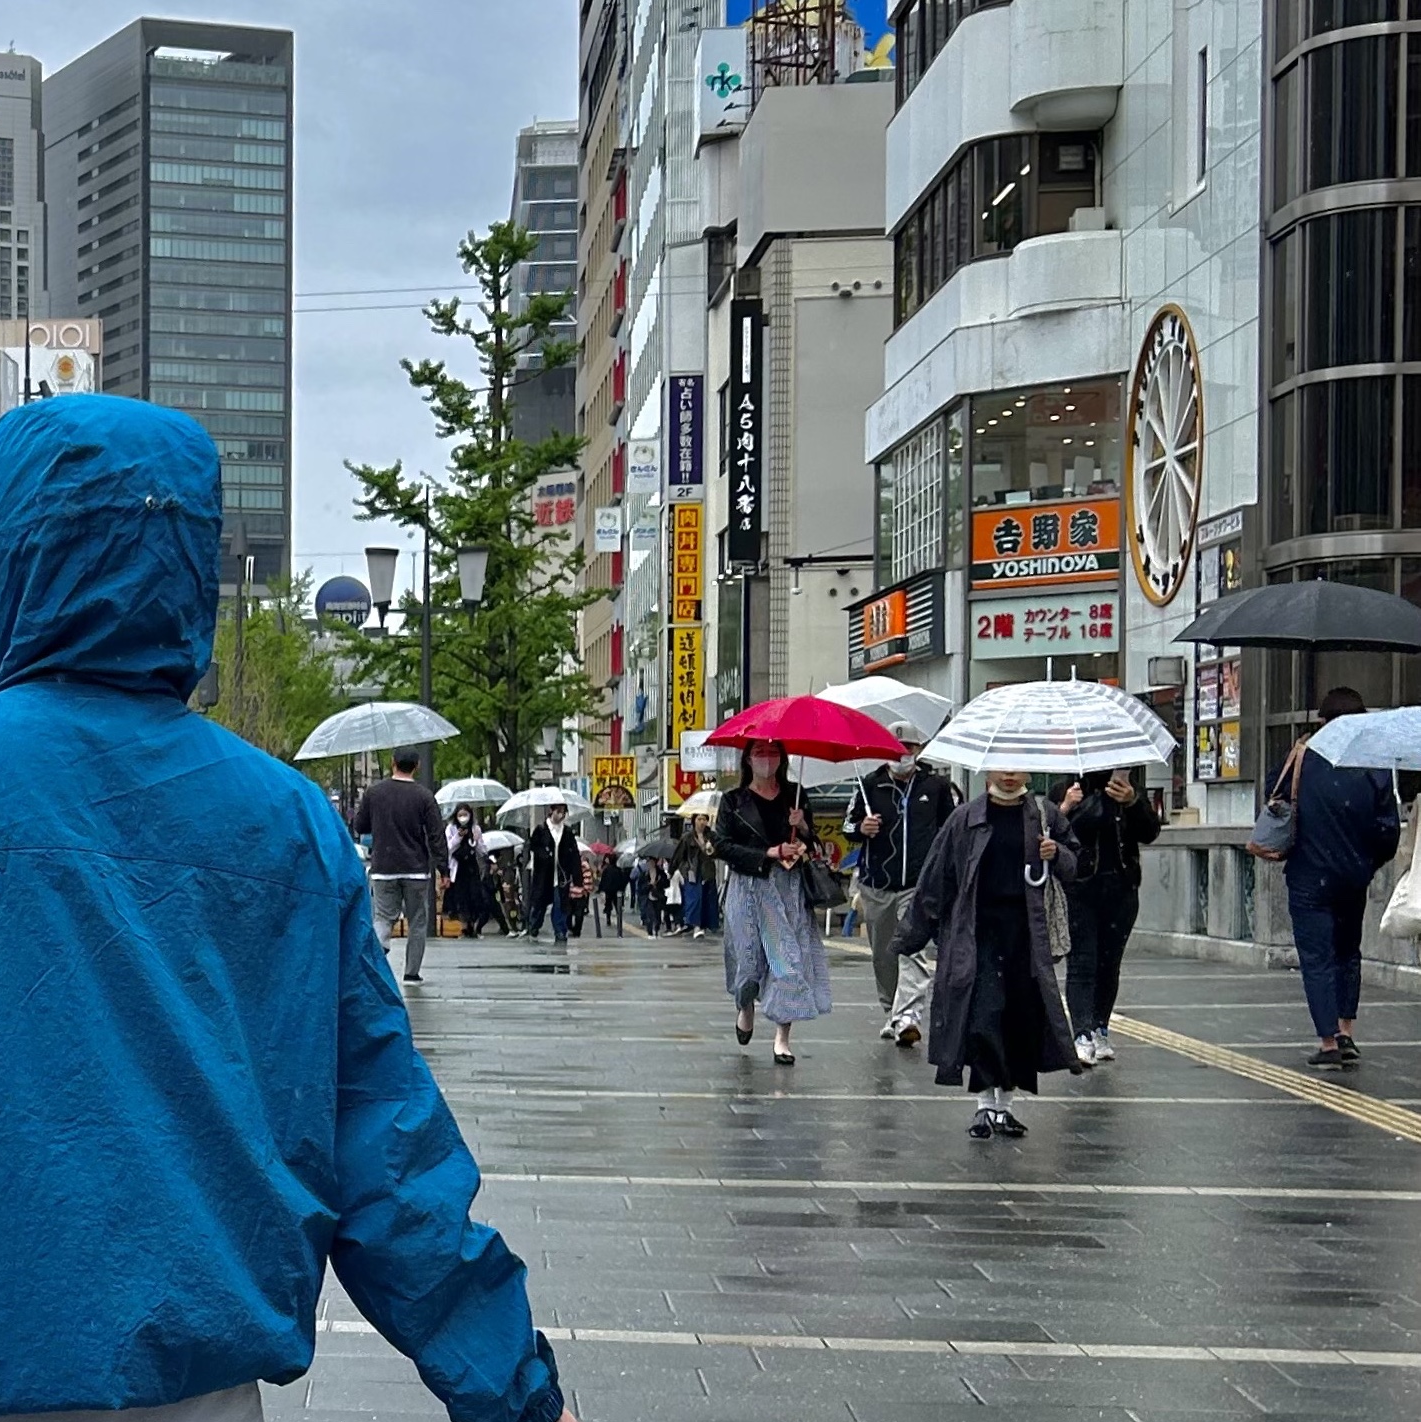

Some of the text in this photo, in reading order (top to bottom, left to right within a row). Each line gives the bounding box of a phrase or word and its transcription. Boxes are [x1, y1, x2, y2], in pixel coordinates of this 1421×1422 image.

[677, 487, 693, 497] 2F
[534, 498, 575, 527] 近鉄
[991, 507, 1100, 557] 吉野家
[992, 554, 1100, 579] YOSHINOYA
[977, 613, 1014, 640] 2階
[1024, 603, 1113, 625] カウンター 8席
[1023, 622, 1113, 642] テーブル 16席
[678, 631, 696, 731] 道頓堀肉劇
